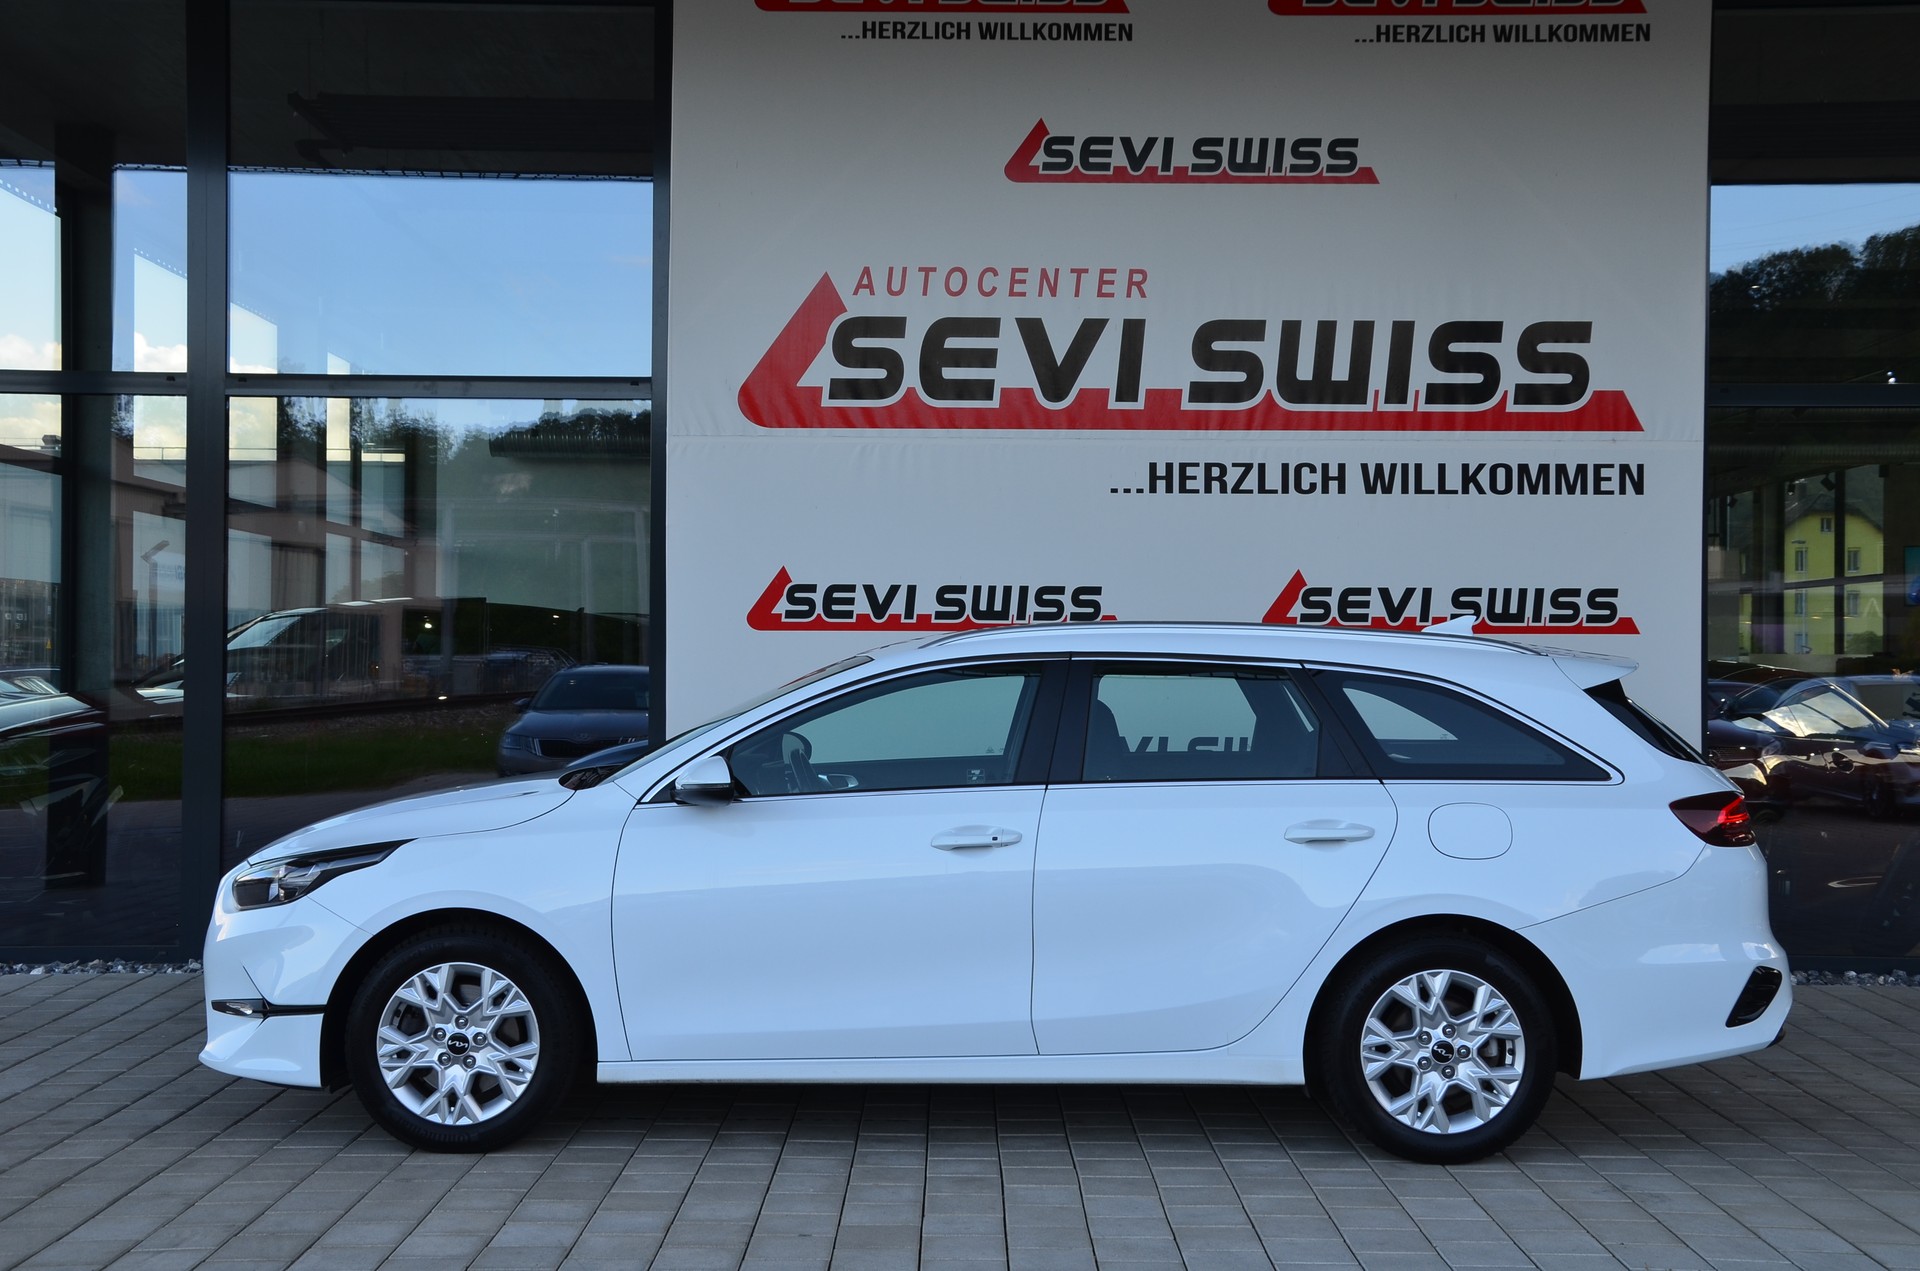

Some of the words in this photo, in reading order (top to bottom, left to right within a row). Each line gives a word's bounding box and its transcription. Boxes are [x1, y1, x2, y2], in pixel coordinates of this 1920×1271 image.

[840, 20, 971, 41] ...HERZLICH
[977, 21, 1133, 42] WILLKOMMEN
[1354, 24, 1486, 43] ...HERZLICH
[1492, 23, 1651, 43] WILLKOMMEN
[1041, 135, 1175, 173] SEVI
[1190, 137, 1360, 174] SWISS
[852, 265, 1149, 299] AUTOCENTER
[828, 315, 1146, 403] SEVI
[1187, 319, 1593, 406] SWISS
[1110, 461, 1346, 495] ...HERZLICH
[1360, 462, 1645, 496] WILLKOMMEN
[783, 583, 917, 621] SEVI
[933, 584, 1103, 622] SWISS
[1299, 586, 1433, 624] SEVI
[1449, 587, 1619, 625] SWISS
